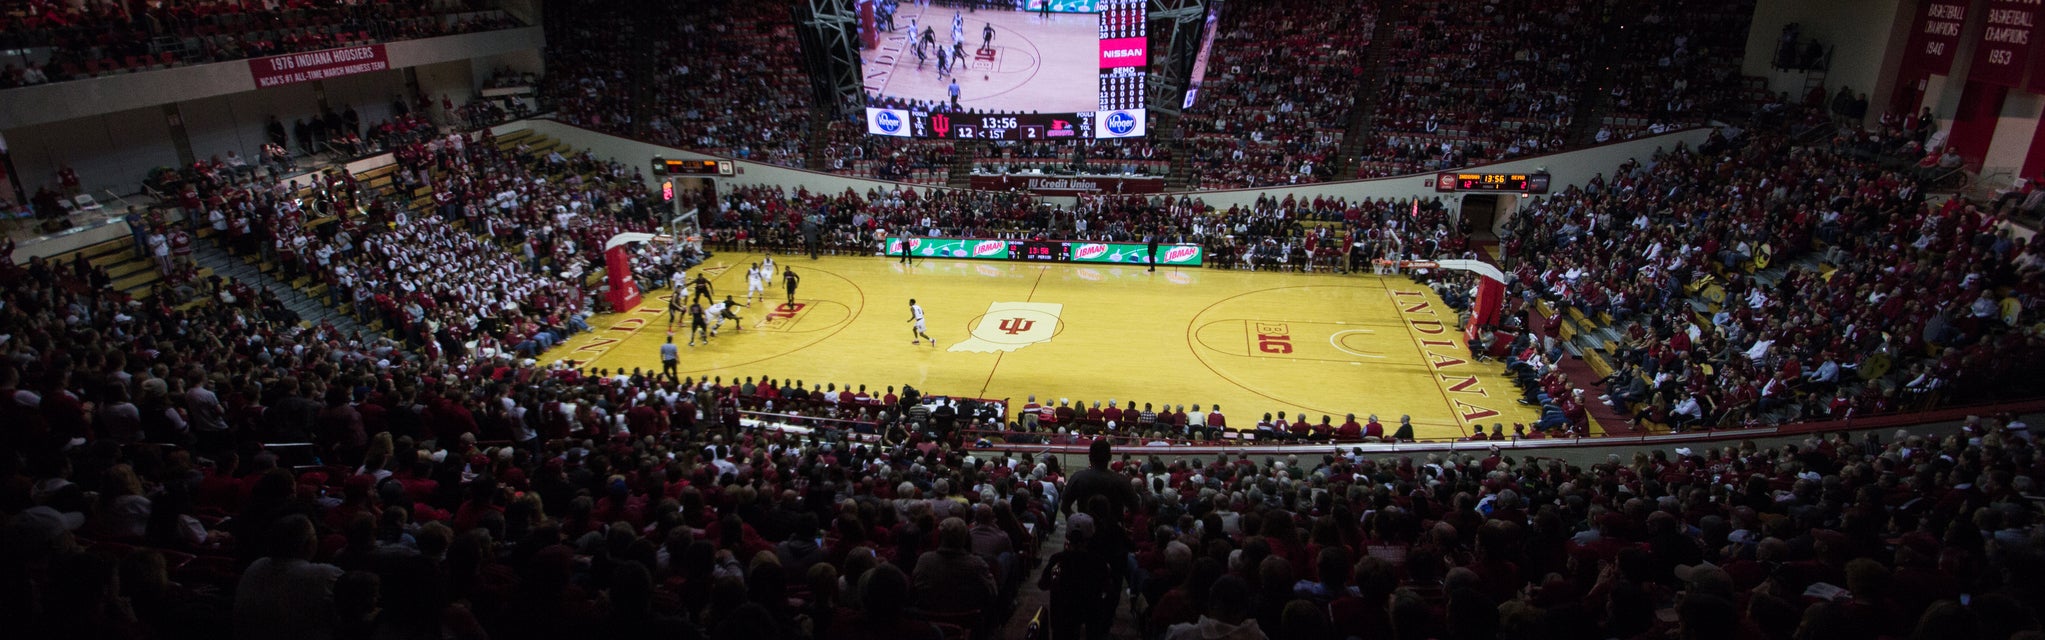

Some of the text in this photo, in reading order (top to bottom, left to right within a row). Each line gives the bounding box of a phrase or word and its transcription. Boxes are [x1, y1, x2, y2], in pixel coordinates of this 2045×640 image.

[1104, 48, 1142, 58] NISSAN
[1926, 42, 1944, 55] 1940
[270, 47, 374, 71] 1976 INDIANA HOOSIERS
[1989, 49, 2012, 64] 1953
[295, 71, 323, 81] ALL-TIME
[323, 68, 344, 78] MARCH
[345, 64, 371, 74] MADNESS
[372, 61, 386, 70] TEAM
[878, 114, 899, 130] Kroger
[983, 118, 1017, 128] 13:56
[1109, 115, 1133, 132] Kroger
[959, 128, 973, 138] 12
[1028, 128, 1036, 138] 2
[1028, 179, 1096, 188] IU Credit Union
[973, 241, 1003, 257] LIBMAN
[1074, 244, 1105, 259] LIBMAN
[1164, 248, 1195, 263] LIBMAN
[1393, 290, 1500, 422] INDIANA
